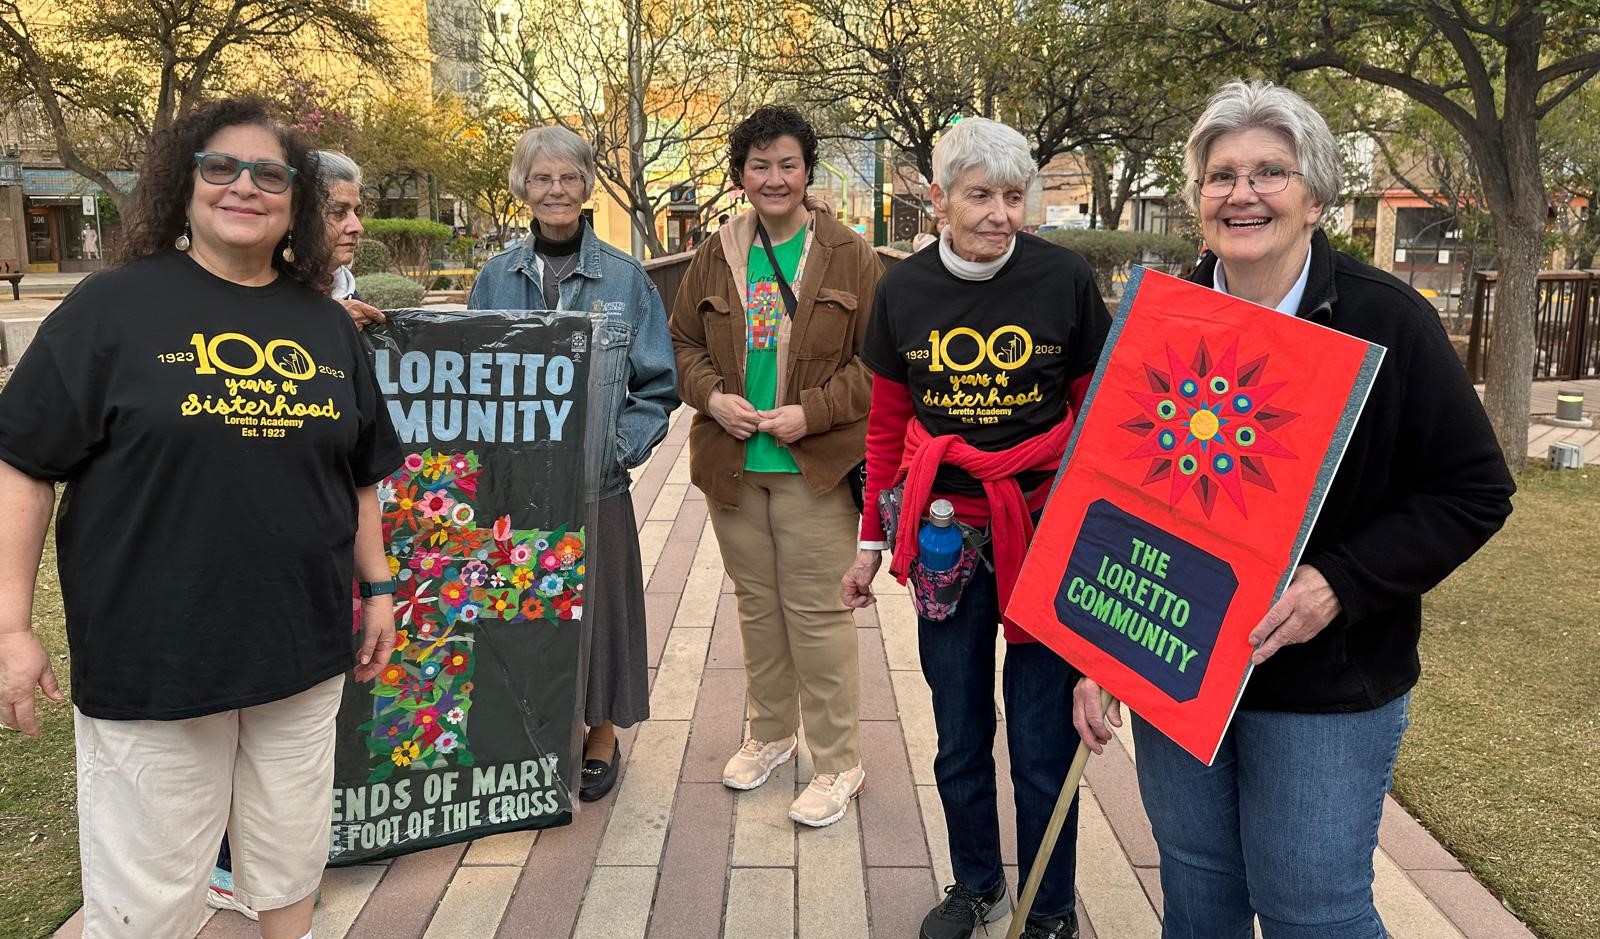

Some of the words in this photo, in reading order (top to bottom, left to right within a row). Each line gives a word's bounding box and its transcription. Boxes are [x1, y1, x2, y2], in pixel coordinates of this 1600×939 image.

[157, 352, 195, 364] 1923
[190, 332, 317, 380] 100
[318, 365, 345, 379] 2023
[905, 349, 930, 360] 1923
[928, 324, 1033, 372] 100
[1034, 345, 1062, 355] 2023
[225, 378, 277, 396] years
[282, 379, 298, 395] of
[375, 350, 575, 396] LORETTO
[949, 373, 992, 390] years
[995, 371, 1010, 388] of
[180, 393, 341, 420] Sisterhood
[224, 416, 258, 426] Loretto
[259, 417, 304, 429] Academy
[386, 399, 574, 444] MUNITY
[948, 407, 975, 415] Loretto
[976, 407, 1012, 416] Academy
[978, 416, 999, 425] 1923
[241, 427, 259, 437] Est.
[261, 428, 286, 438] 1923
[1130, 537, 1172, 579] THE
[1096, 555, 1190, 628] LORETTO
[1067, 576, 1199, 674] COMMUNITY
[331, 778, 412, 822] ENDS
[423, 771, 460, 805] OF
[472, 757, 559, 798] MARY
[347, 815, 403, 851] FOOT
[407, 809, 436, 841] OF
[440, 800, 481, 833] THE
[488, 789, 560, 825] CROSS
